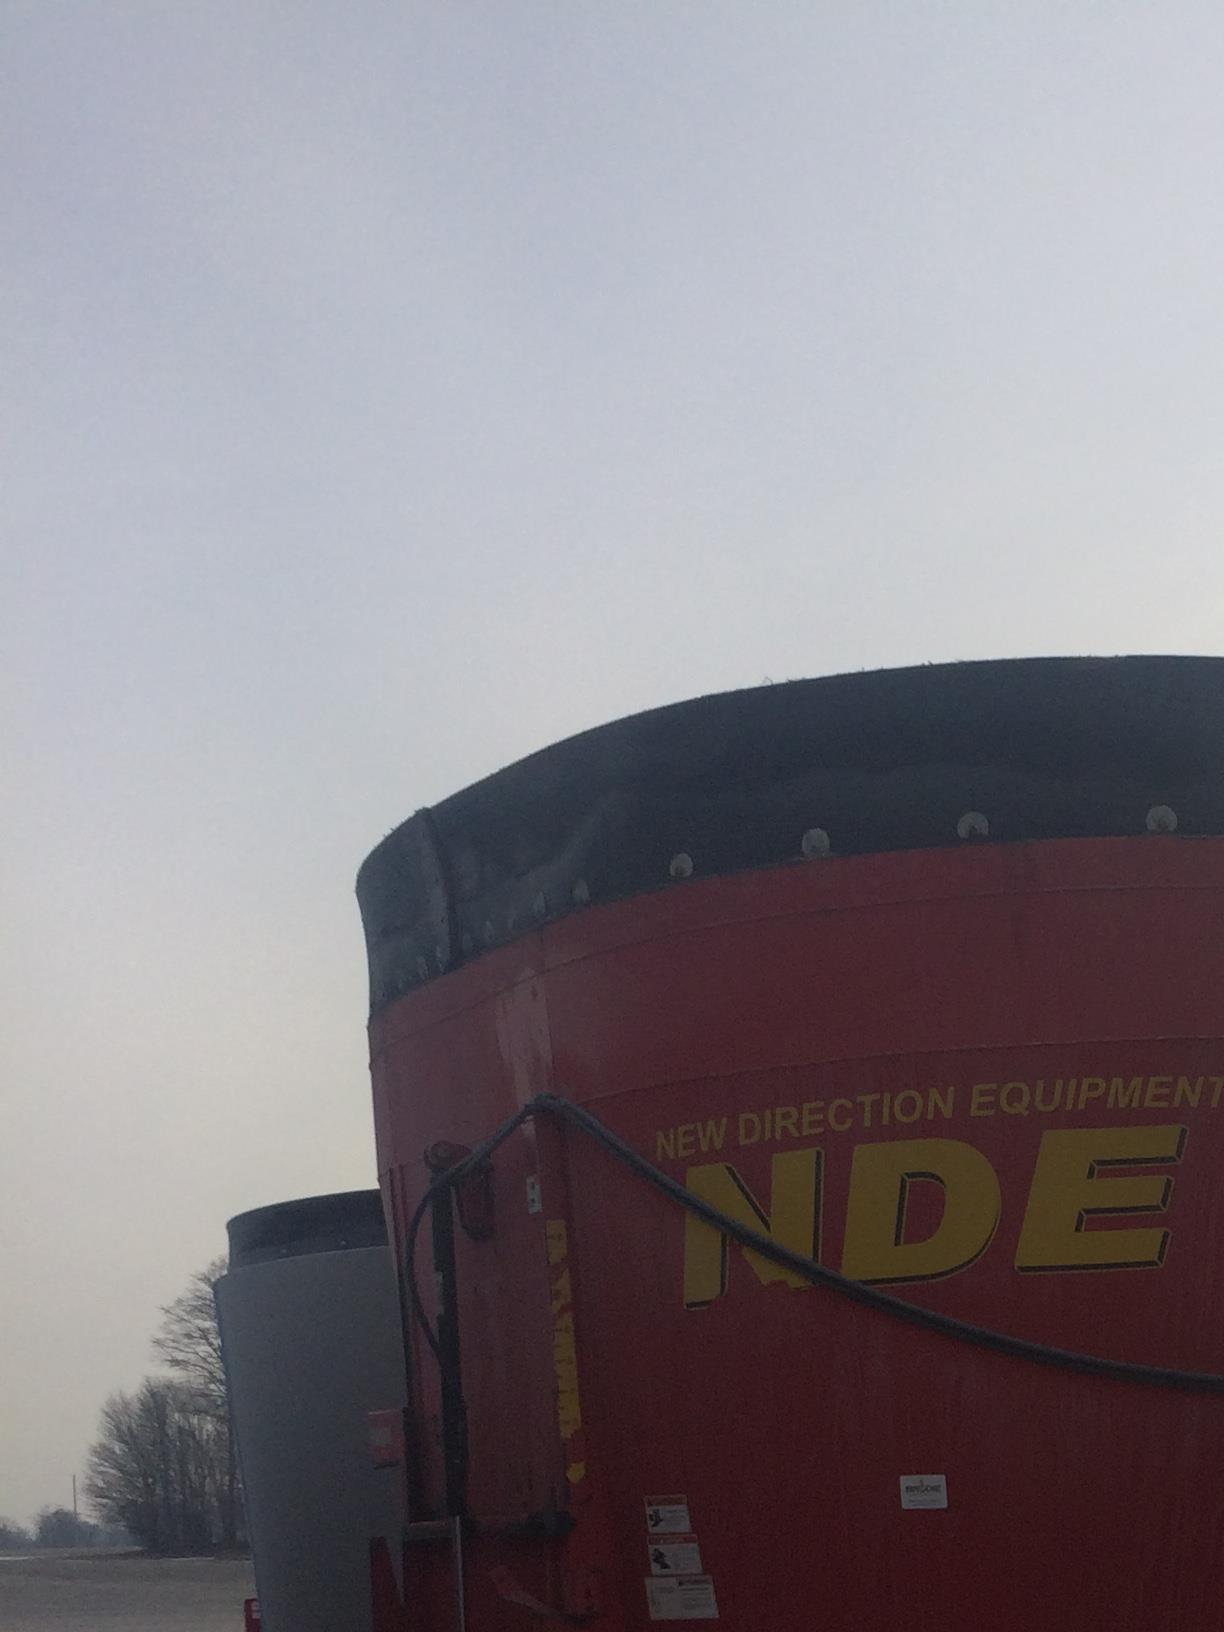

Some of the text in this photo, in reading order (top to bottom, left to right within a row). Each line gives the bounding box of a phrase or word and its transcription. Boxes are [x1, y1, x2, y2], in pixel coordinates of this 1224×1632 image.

[656, 1117, 728, 1162] NEW
[737, 1086, 956, 1147] DIRECTION
[683, 1124, 1188, 1311] NDE
